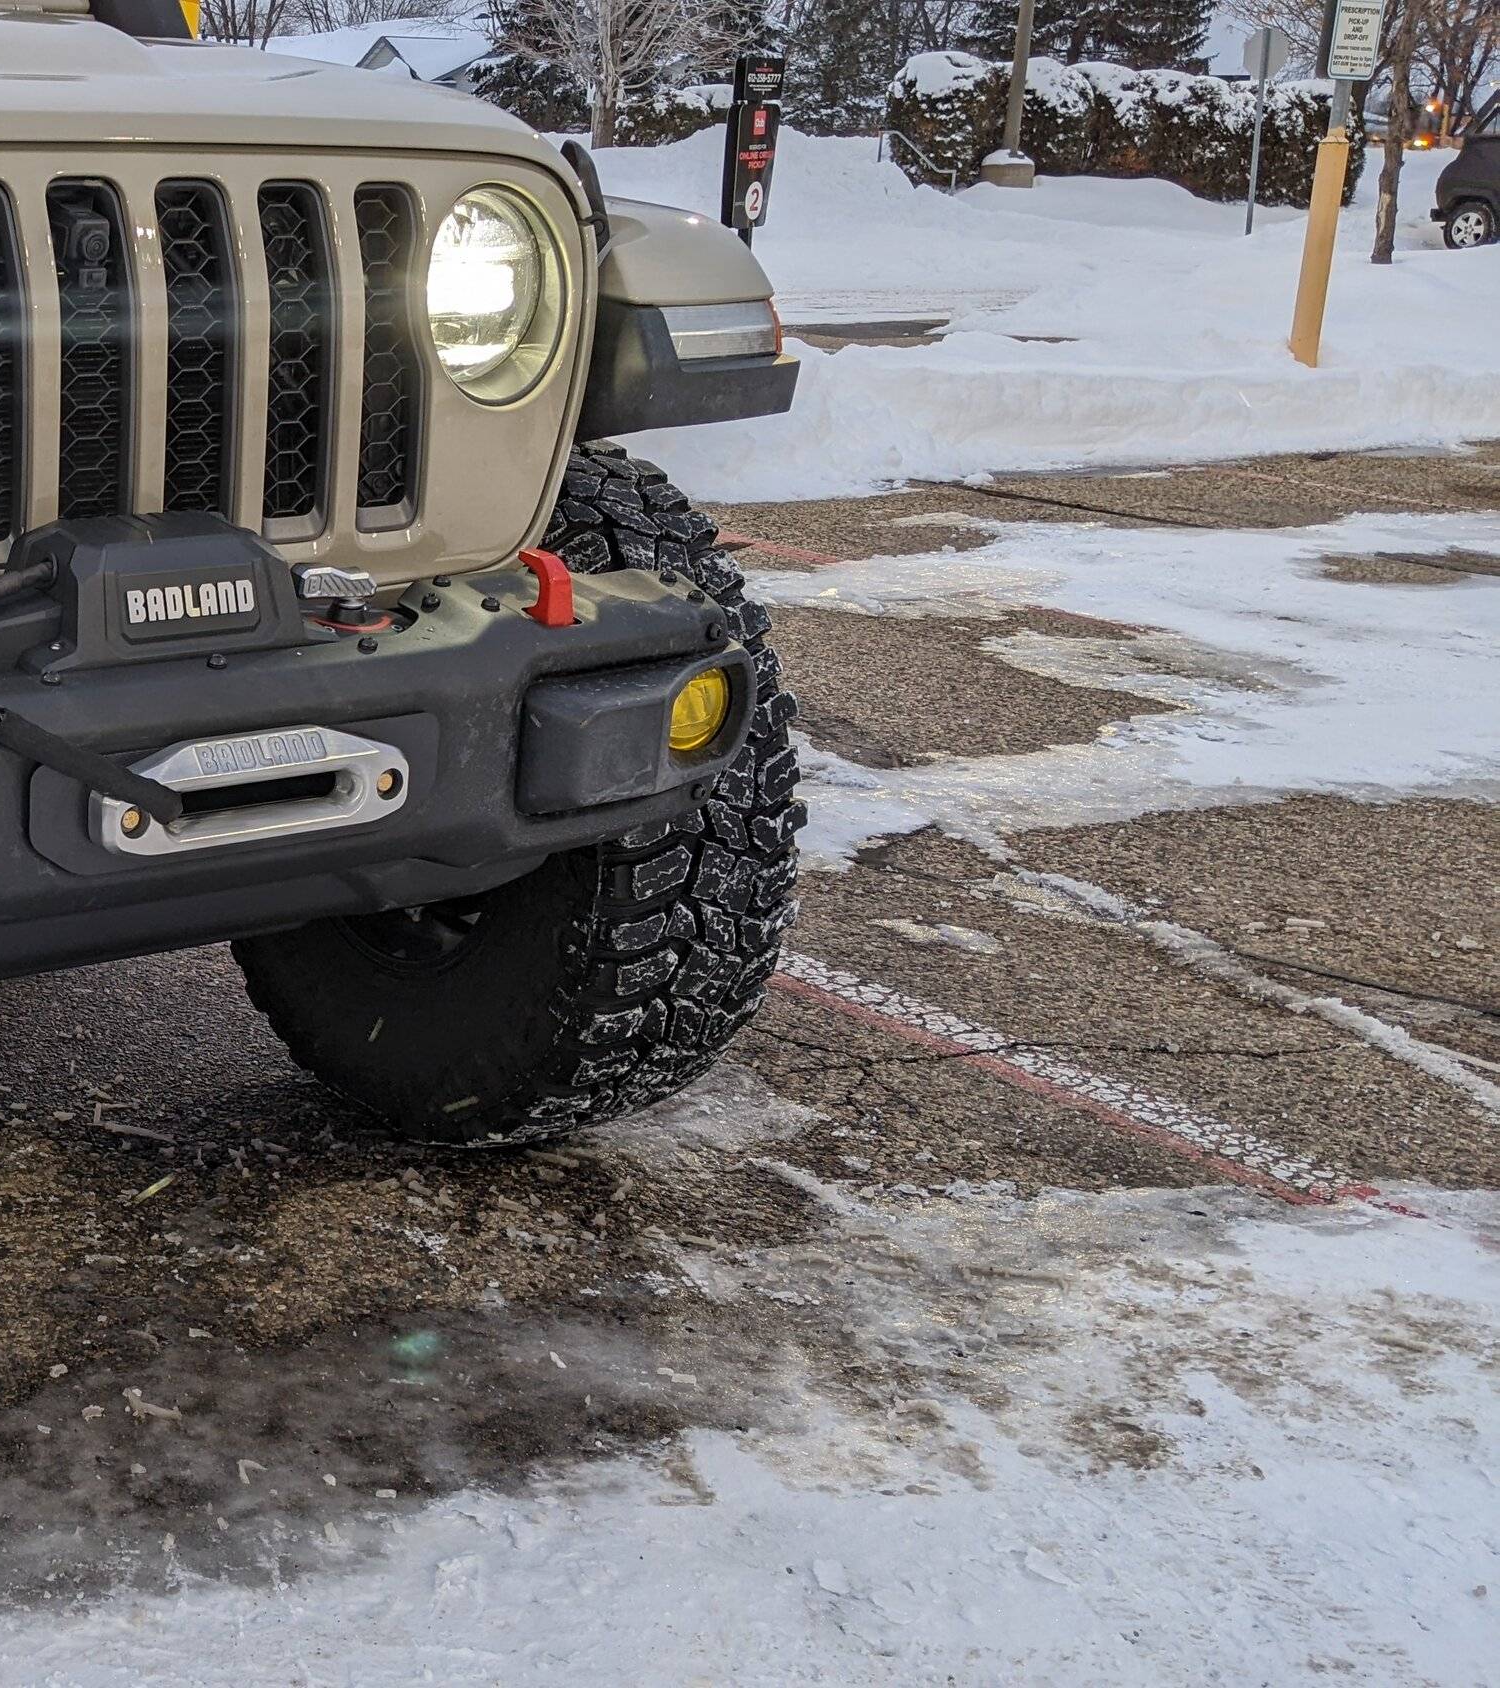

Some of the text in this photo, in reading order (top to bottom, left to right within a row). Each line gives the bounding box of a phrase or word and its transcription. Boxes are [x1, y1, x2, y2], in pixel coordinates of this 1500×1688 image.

[1340, 6, 1380, 15] PRESCRIPTION
[749, 187, 760, 211] 2
[126, 579, 255, 624] BADLAND
[194, 730, 328, 776] BADLAND
